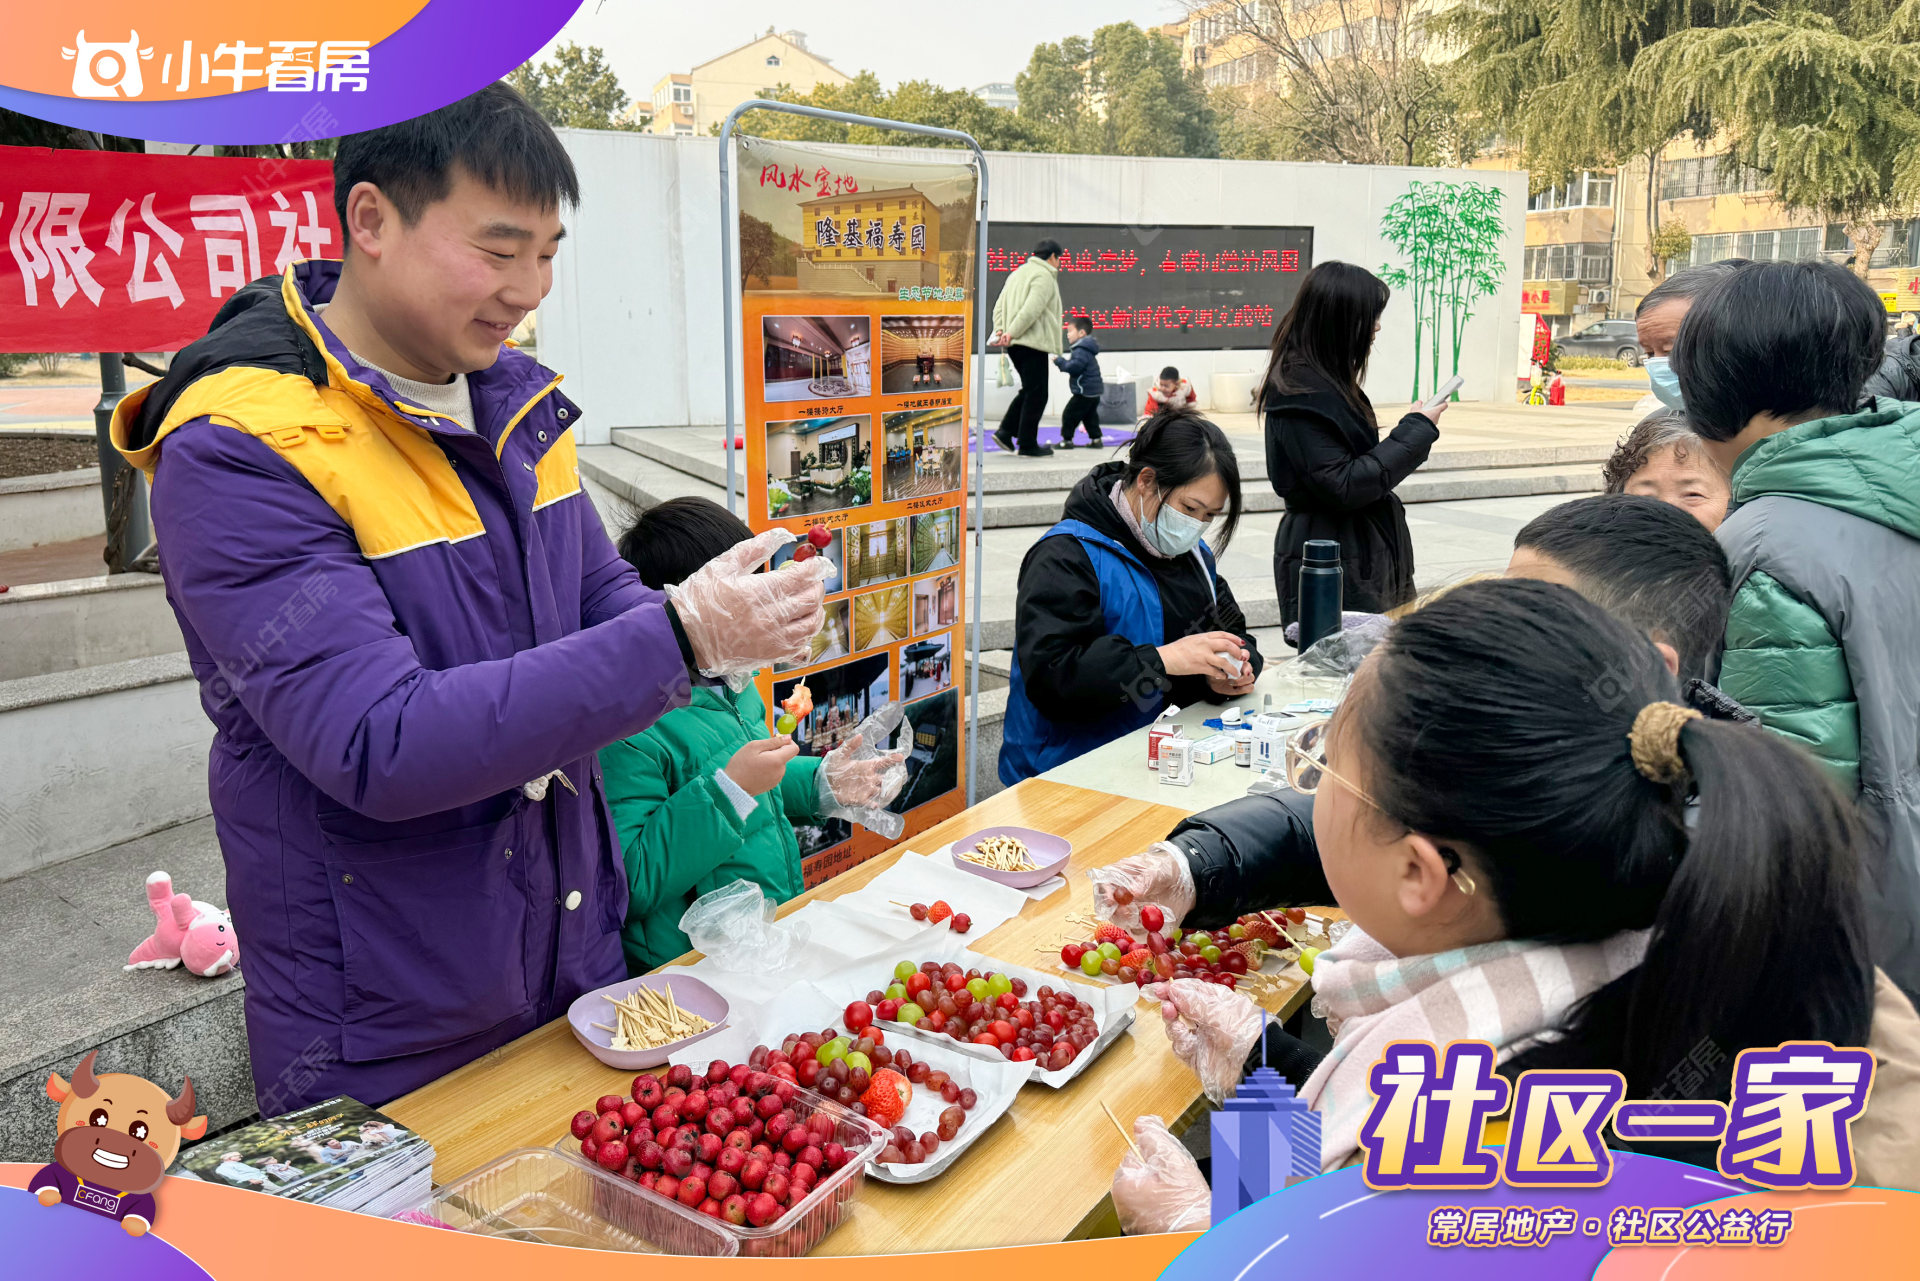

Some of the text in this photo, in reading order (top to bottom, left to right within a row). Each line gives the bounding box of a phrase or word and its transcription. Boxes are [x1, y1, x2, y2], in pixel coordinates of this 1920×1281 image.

[760, 163, 859, 197] 风水宝地
[0, 191, 332, 310] 限公司社
[815, 215, 926, 252] 隆基福寿园
